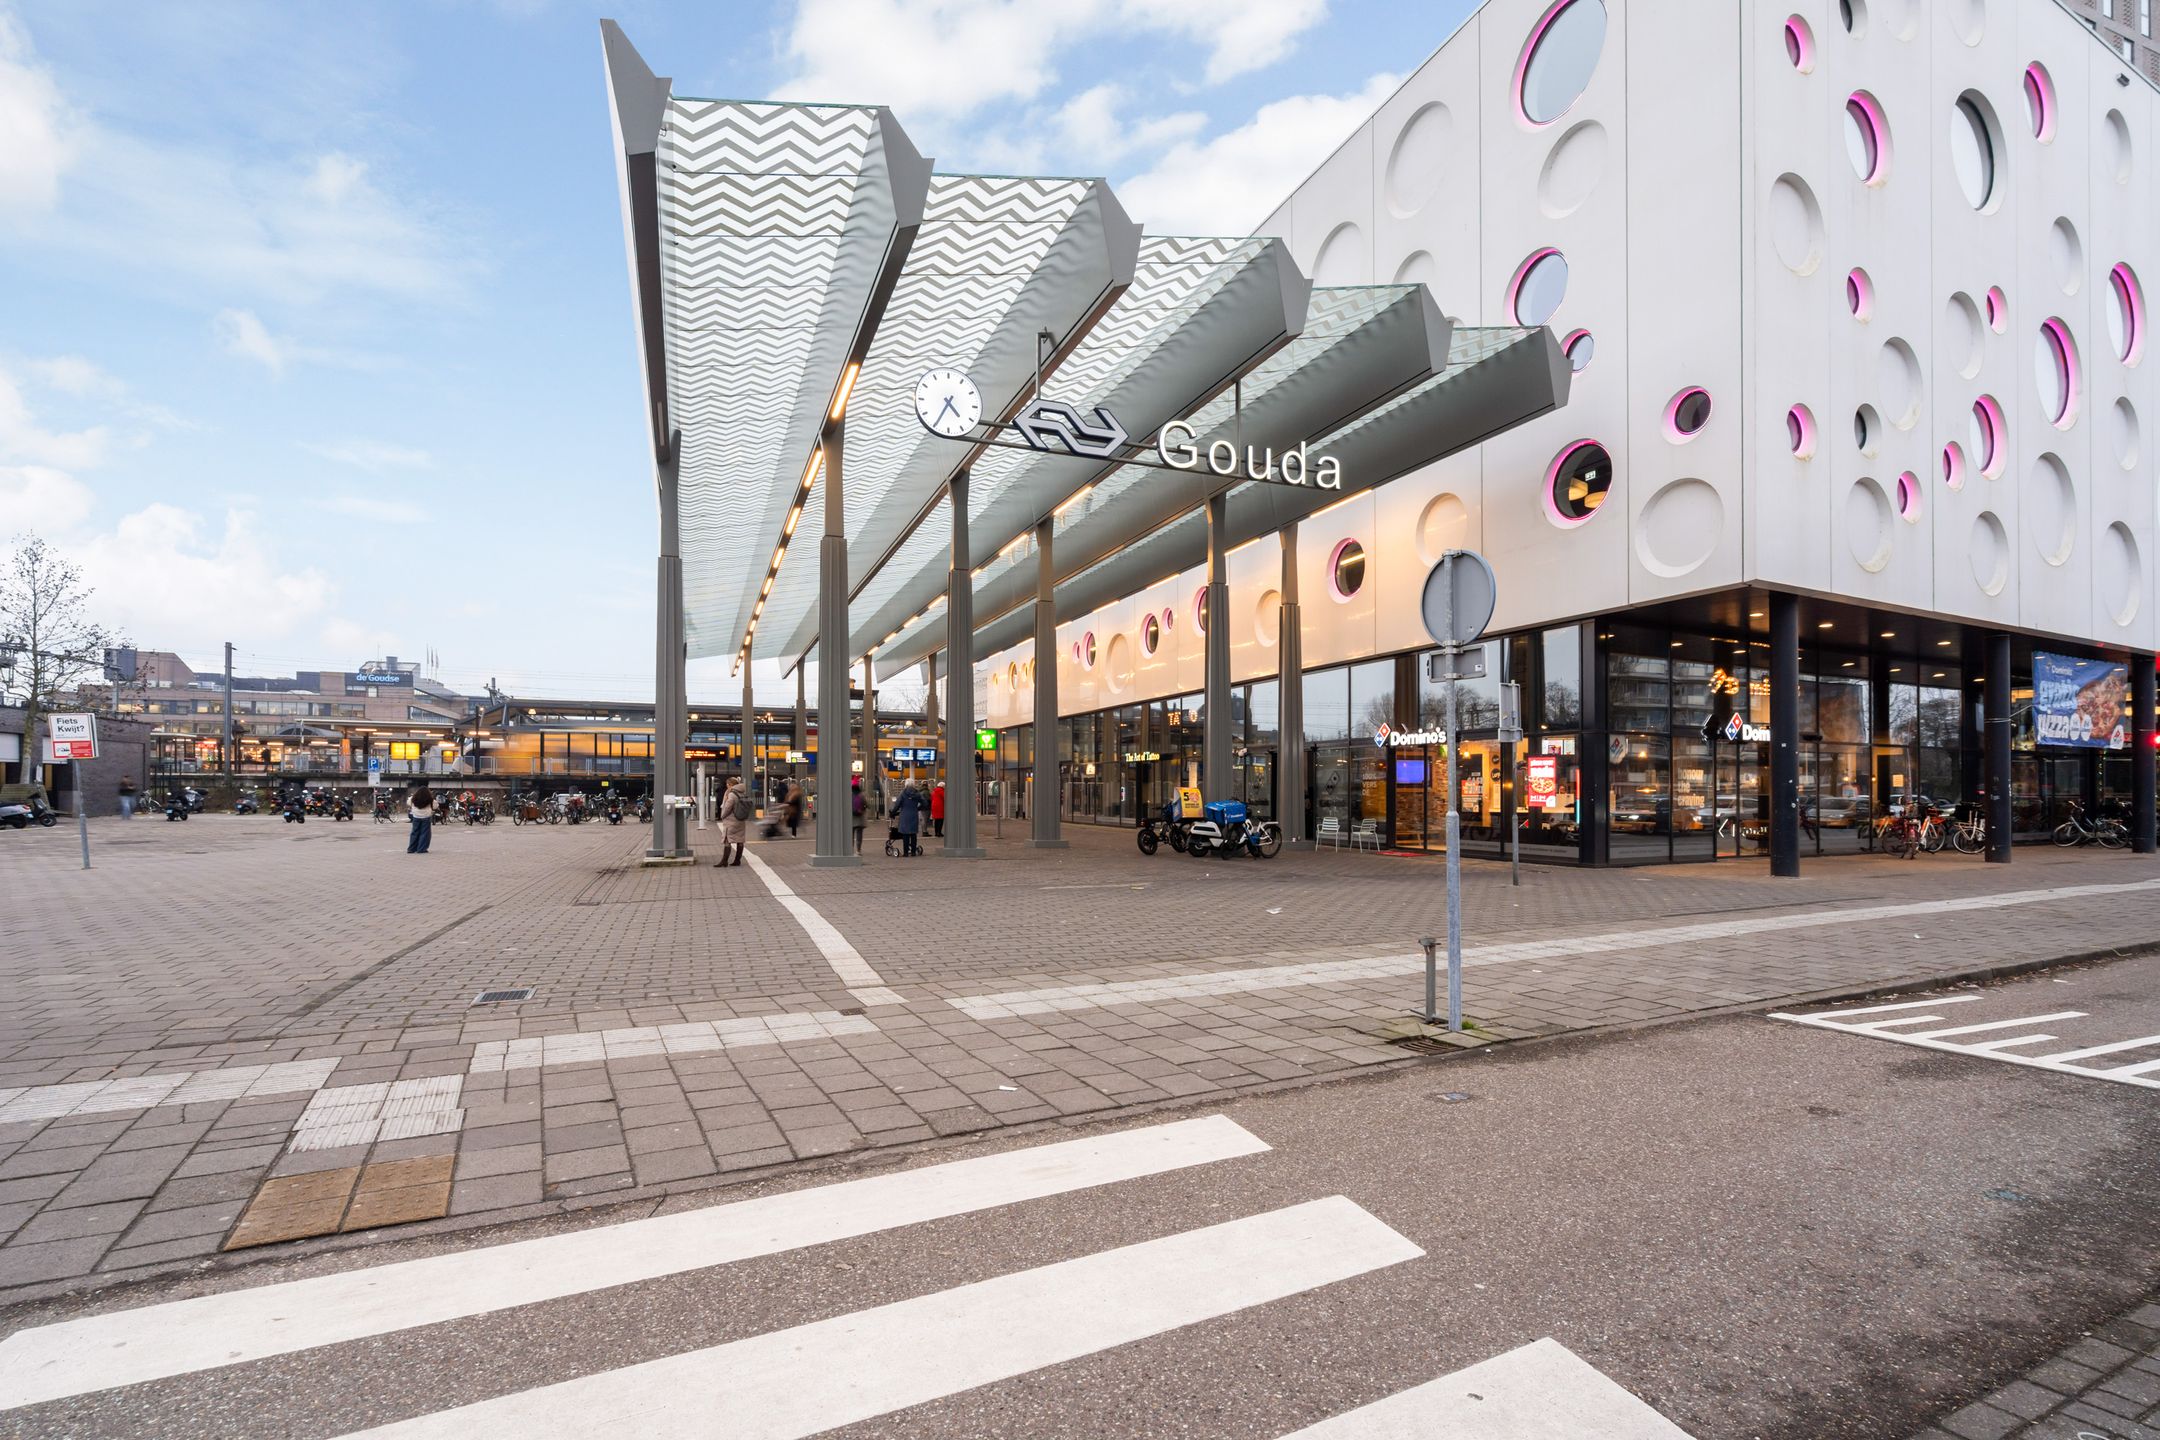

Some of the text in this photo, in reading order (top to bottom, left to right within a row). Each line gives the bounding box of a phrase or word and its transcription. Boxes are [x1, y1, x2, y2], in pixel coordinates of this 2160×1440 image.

[1157, 420, 1342, 490] Gouda
[368, 674, 400, 682] Goudse
[57, 725, 85, 733] Kwijt?
[1390, 727, 1447, 746] Domino's
[1125, 752, 1133, 762] The
[1145, 751, 1160, 761] Tattoo
[1678, 793, 1705, 808] craving
